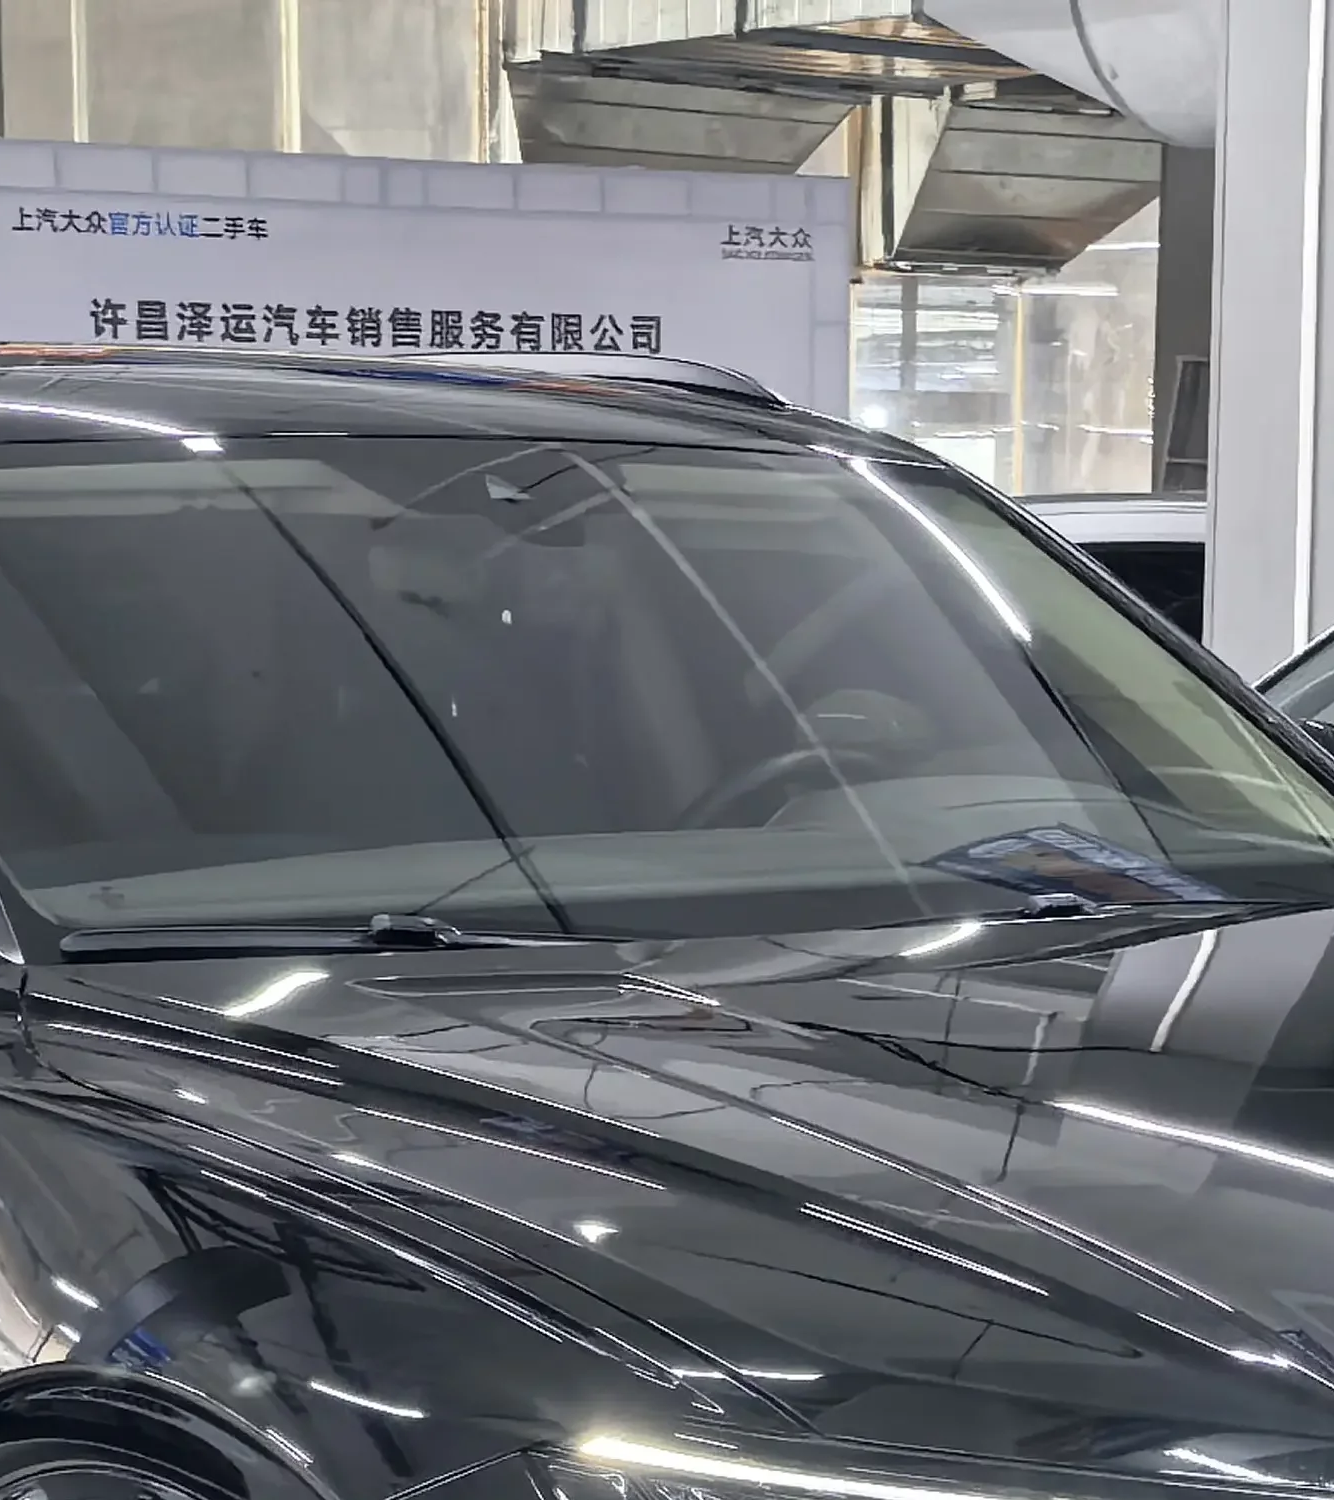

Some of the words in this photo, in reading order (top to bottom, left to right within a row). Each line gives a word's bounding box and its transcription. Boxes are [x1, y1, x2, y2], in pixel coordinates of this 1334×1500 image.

[12, 206, 269, 240] 上汽大众官方认证二手车
[720, 224, 814, 248] 上汽大众
[89, 298, 663, 354] 许昌泽运汽车销售服务有限公司
